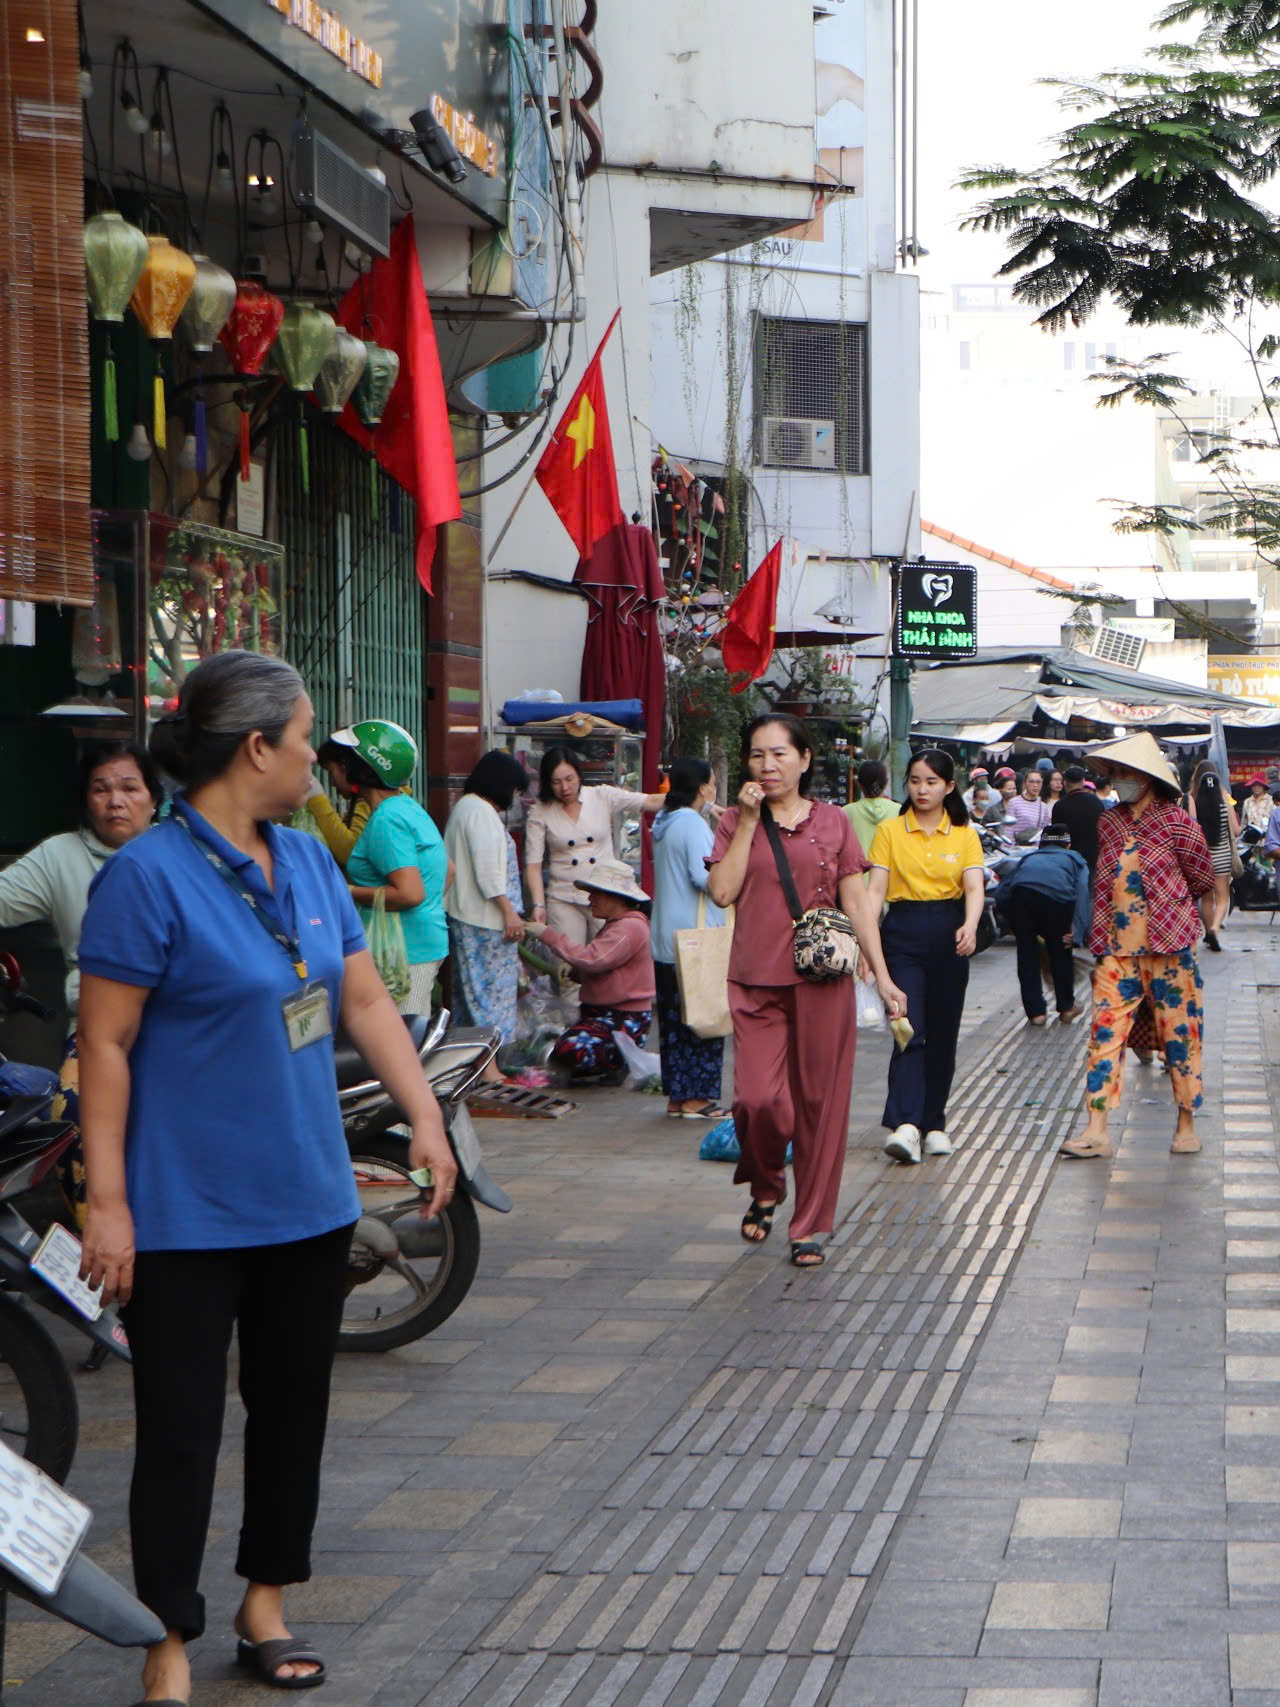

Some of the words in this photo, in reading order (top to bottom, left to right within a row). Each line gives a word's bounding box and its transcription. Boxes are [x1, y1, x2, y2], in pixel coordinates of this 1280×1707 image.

[907, 611, 934, 624] NHA
[935, 611, 966, 625] KHOA
[902, 626, 936, 646] THÁI
[367, 745, 392, 771] Grab
